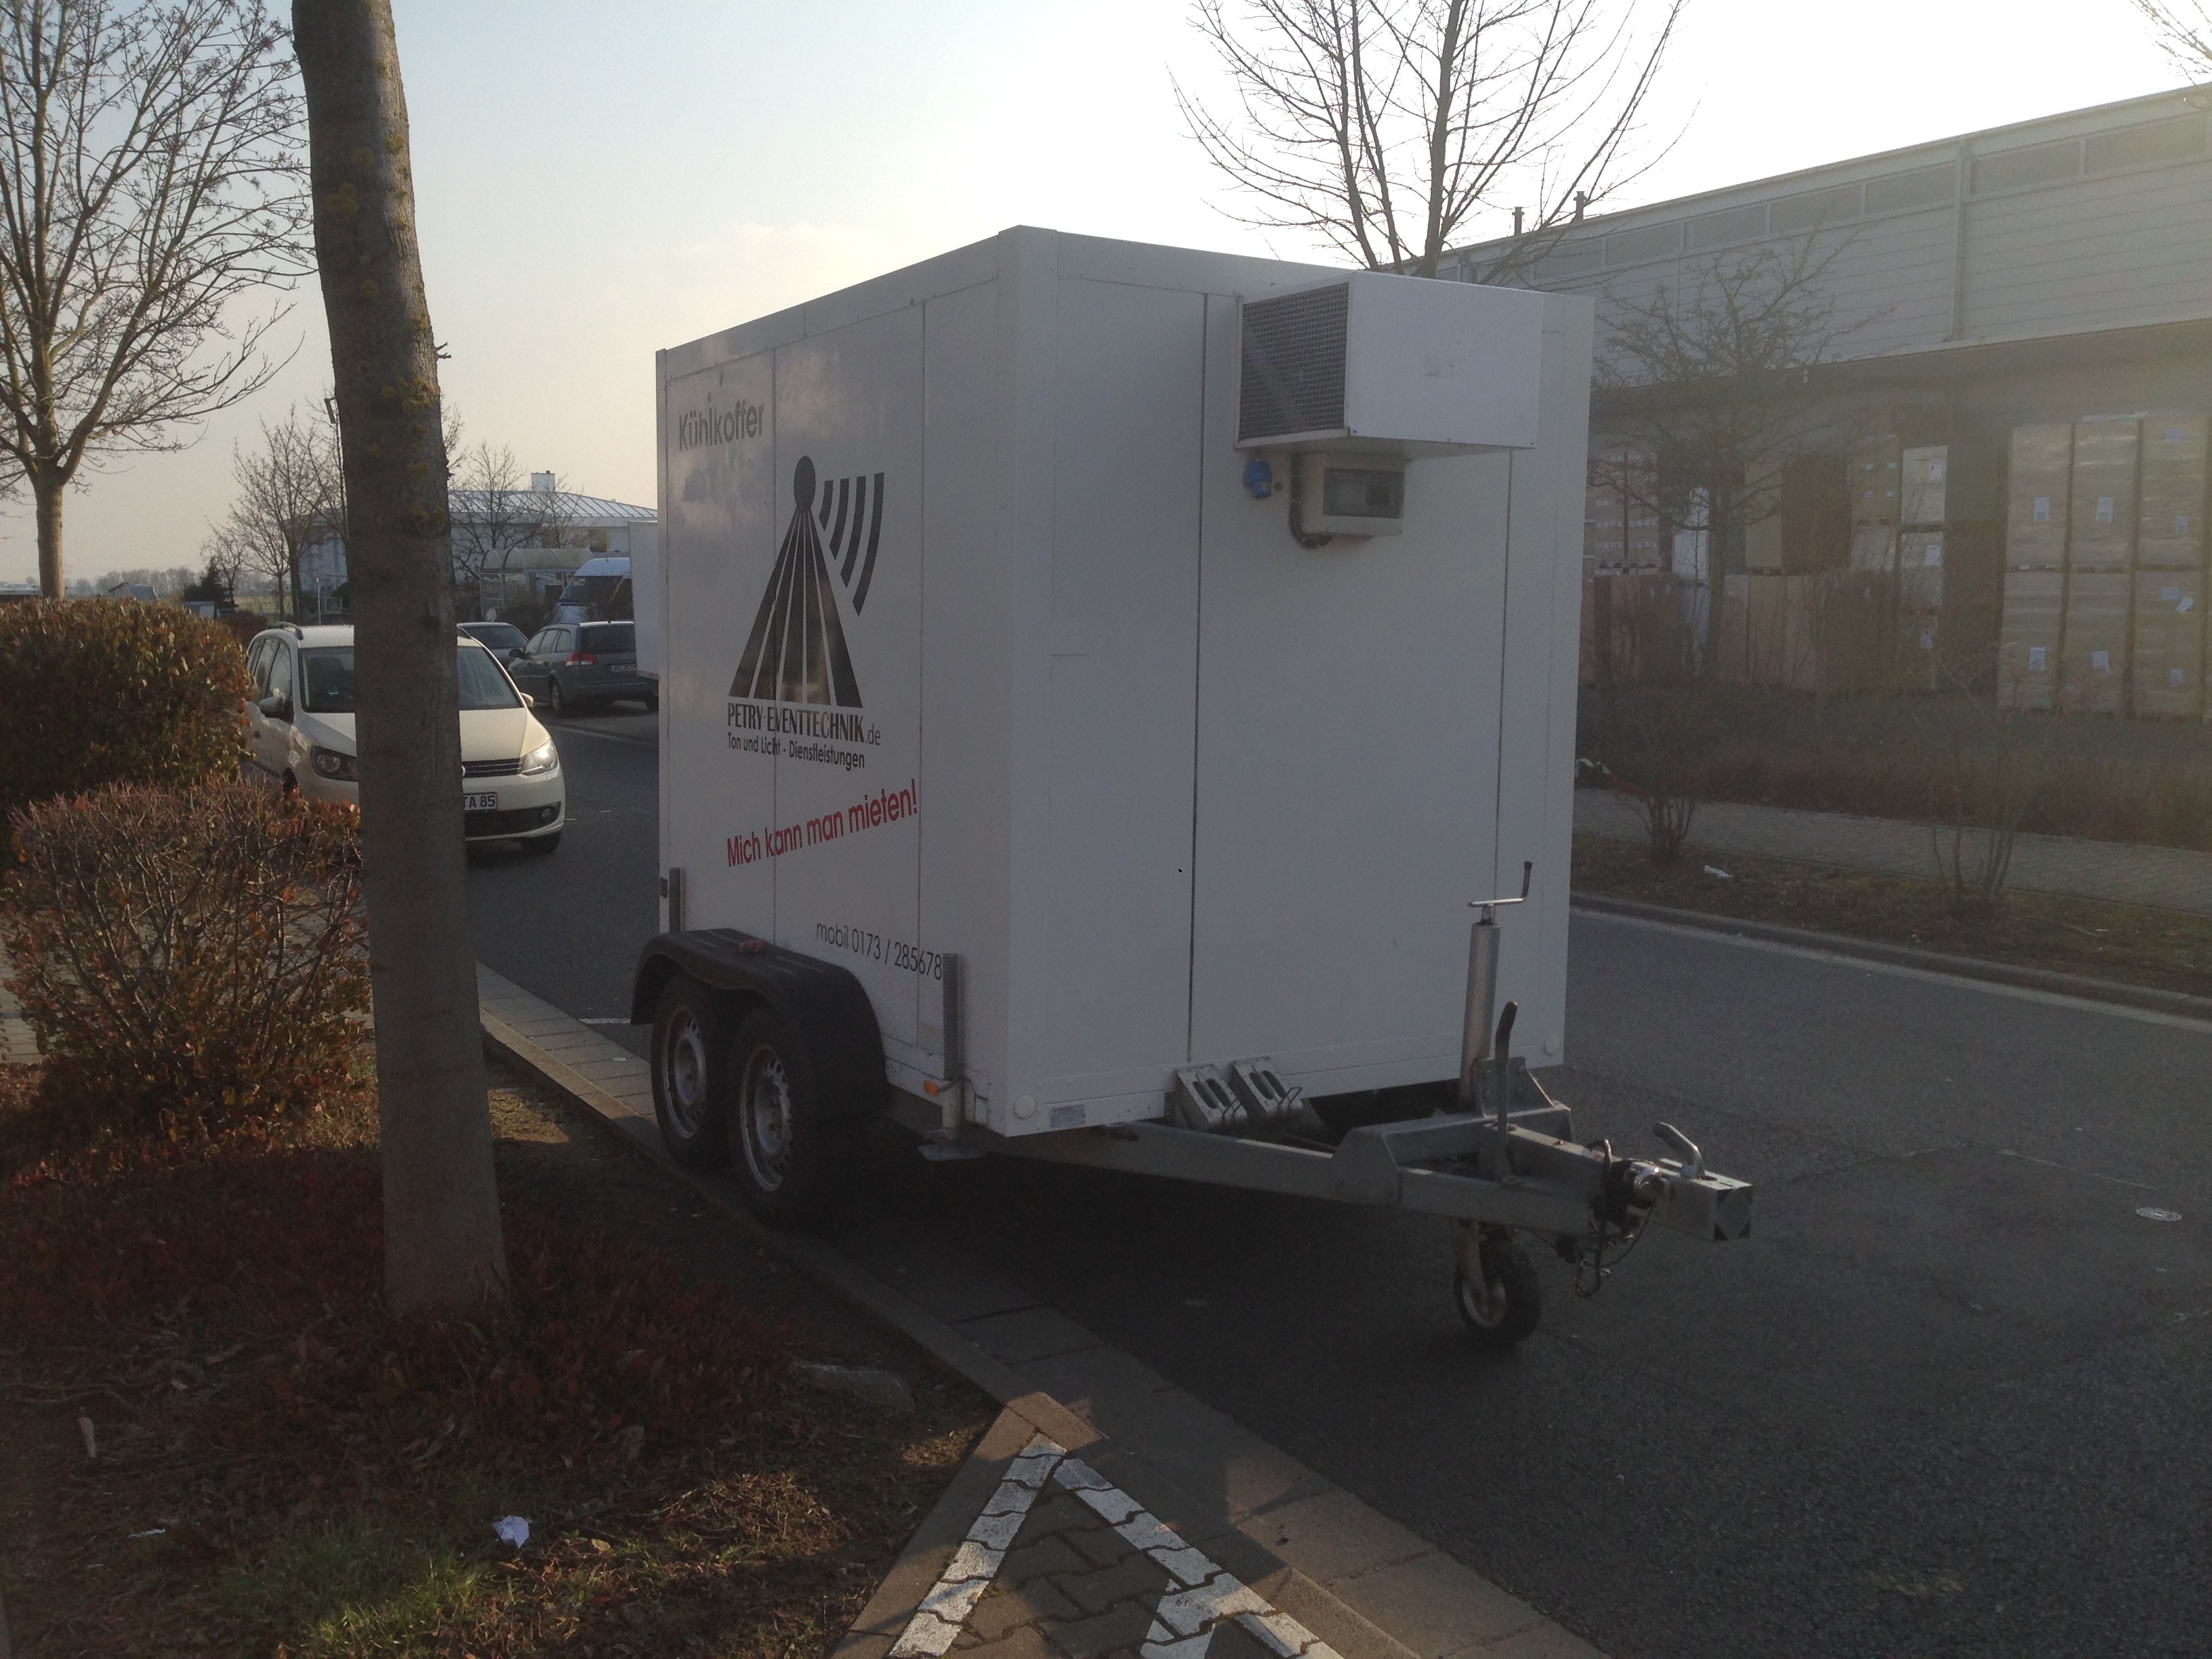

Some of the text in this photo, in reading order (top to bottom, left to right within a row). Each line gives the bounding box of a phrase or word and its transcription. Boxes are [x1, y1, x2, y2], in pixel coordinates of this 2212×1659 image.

[678, 399, 764, 452] Kühlkoffer
[727, 702, 764, 731] PETRY
[727, 732, 865, 772] Ton und Licht Dienstleistungen
[480, 795, 495, 808] 85
[726, 778, 918, 867] Mich kann man mieten!
[816, 922, 848, 949] mobil
[852, 928, 881, 960] 0173
[895, 941, 942, 981] 285678
